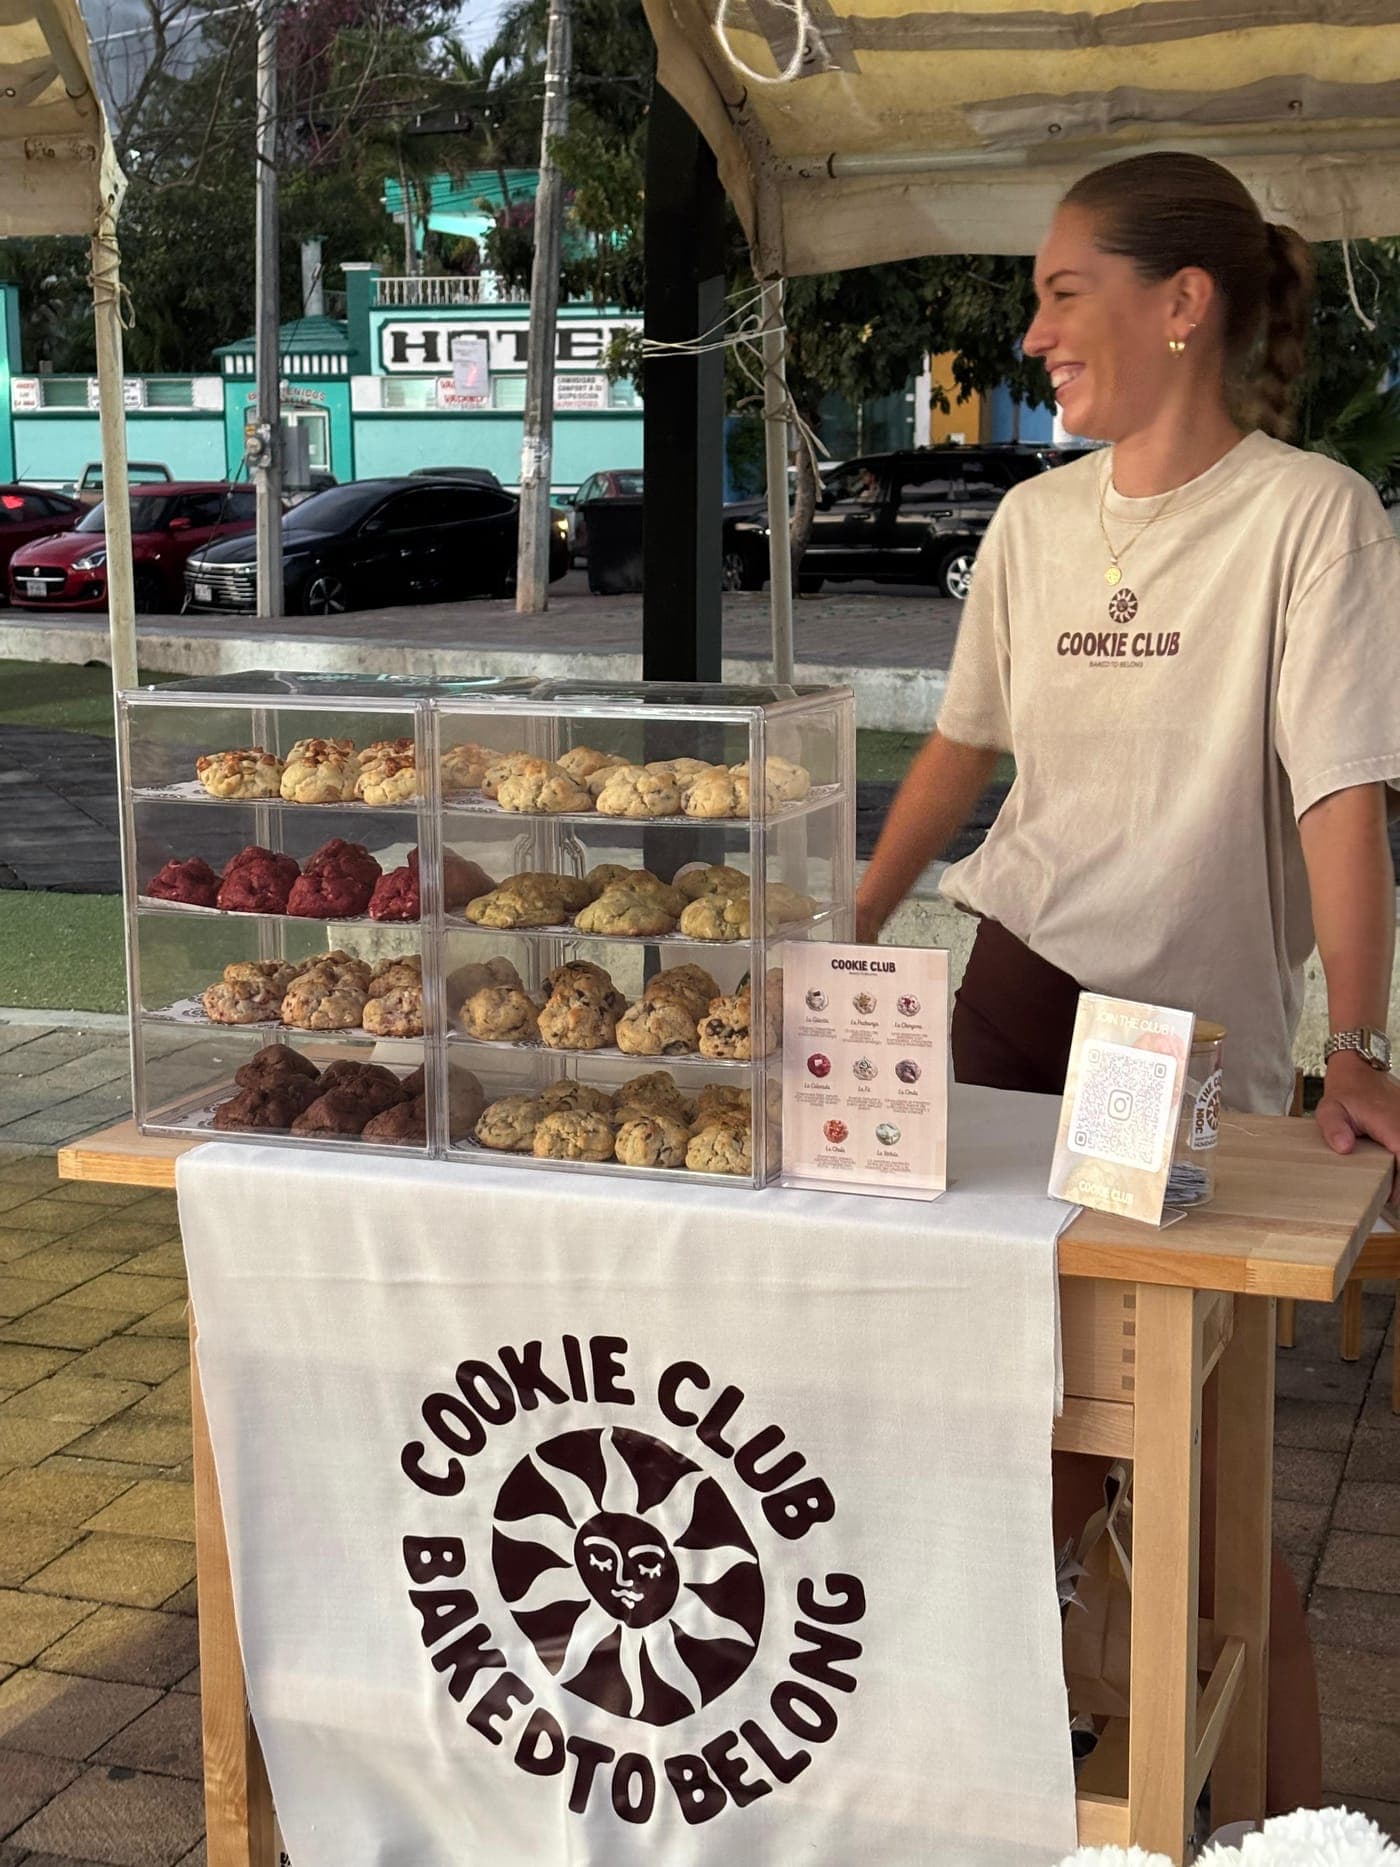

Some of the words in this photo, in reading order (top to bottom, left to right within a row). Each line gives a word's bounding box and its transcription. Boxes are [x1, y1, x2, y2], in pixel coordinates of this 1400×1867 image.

[1057, 632, 1128, 657] COOKIE
[1131, 631, 1181, 657] CLUB
[831, 958, 868, 971] COOKIE
[870, 961, 896, 973] CLUB
[1119, 1015, 1139, 1029] THE
[1140, 1020, 1169, 1035] CLUB
[400, 1334, 635, 1497] COOKIE
[657, 1360, 835, 1540] CLUB
[402, 1535, 566, 1776] BAKED
[566, 1735, 656, 1825] TO
[663, 1573, 866, 1825] BELONG
